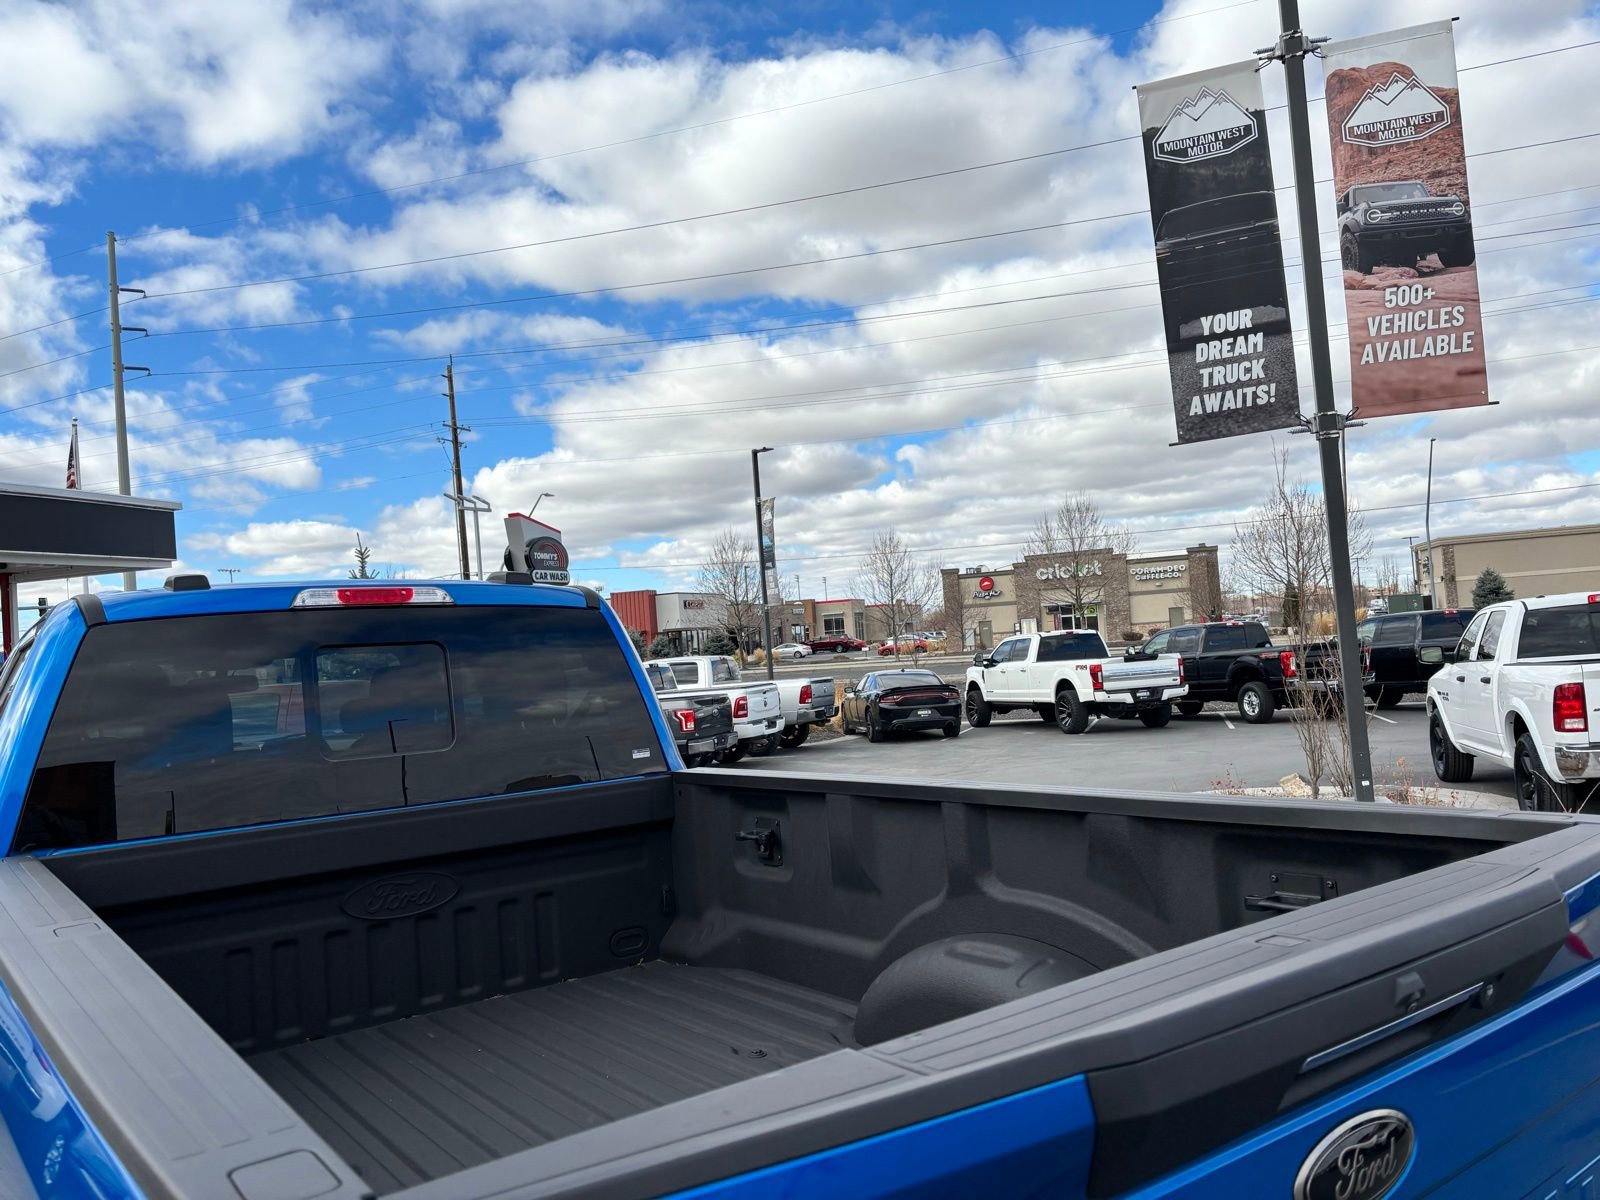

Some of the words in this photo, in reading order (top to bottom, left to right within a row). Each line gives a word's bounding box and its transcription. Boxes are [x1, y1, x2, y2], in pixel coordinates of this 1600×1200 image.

[1163, 133, 1215, 152] MOUNTAIN
[1217, 125, 1245, 140] WEST
[1353, 118, 1407, 136] MOUNTAIN
[1409, 112, 1437, 125] WEST
[1378, 126, 1415, 141] MOTOR
[1187, 141, 1224, 157] MOTOR
[1384, 284, 1436, 308] 500+
[1200, 308, 1253, 336] YOUR
[1367, 305, 1465, 337] VEHICLES
[1195, 332, 1264, 363] DREAM
[1360, 331, 1475, 365] AVAILABLE
[1199, 358, 1266, 388] TRUCK
[1189, 383, 1276, 416] AWAITS!
[534, 571, 548, 580] CAR
[549, 571, 568, 580] WASH
[367, 879, 437, 914] Ford
[1335, 1135, 1398, 1200] Ford
